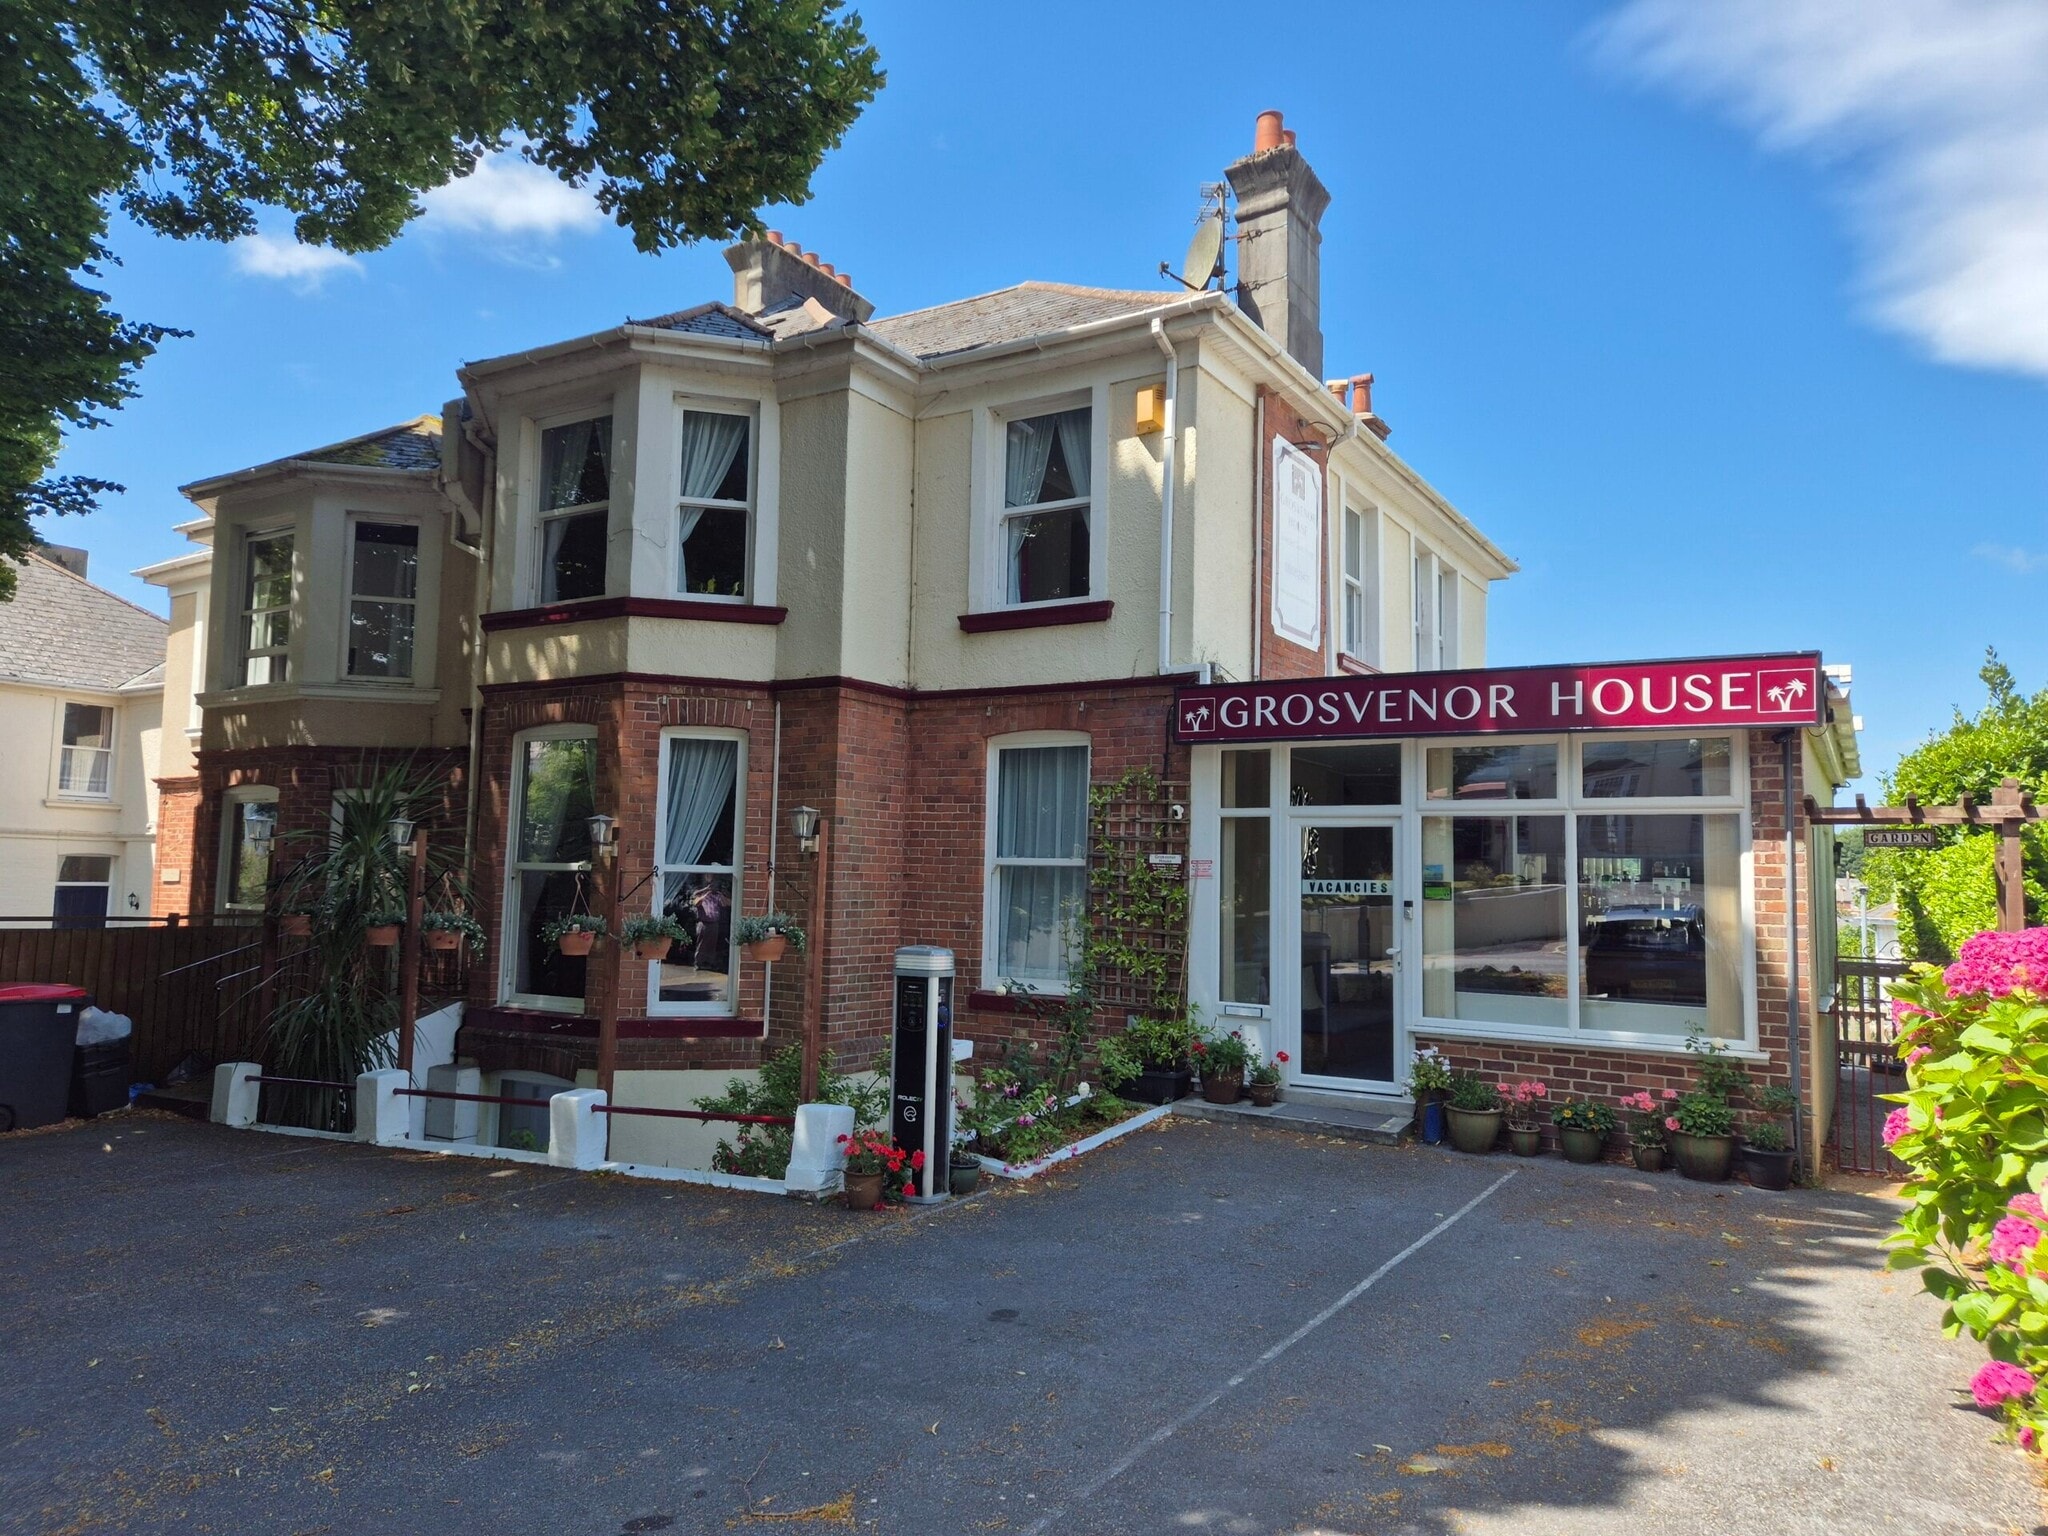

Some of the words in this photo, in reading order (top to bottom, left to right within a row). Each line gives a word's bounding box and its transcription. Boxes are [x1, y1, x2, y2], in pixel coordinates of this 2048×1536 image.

[1219, 684, 1518, 728] GROSVENOR
[1551, 672, 1752, 716] HOUSE
[1870, 833, 1929, 843] GARDEN
[1309, 882, 1388, 893] VACANCIES
